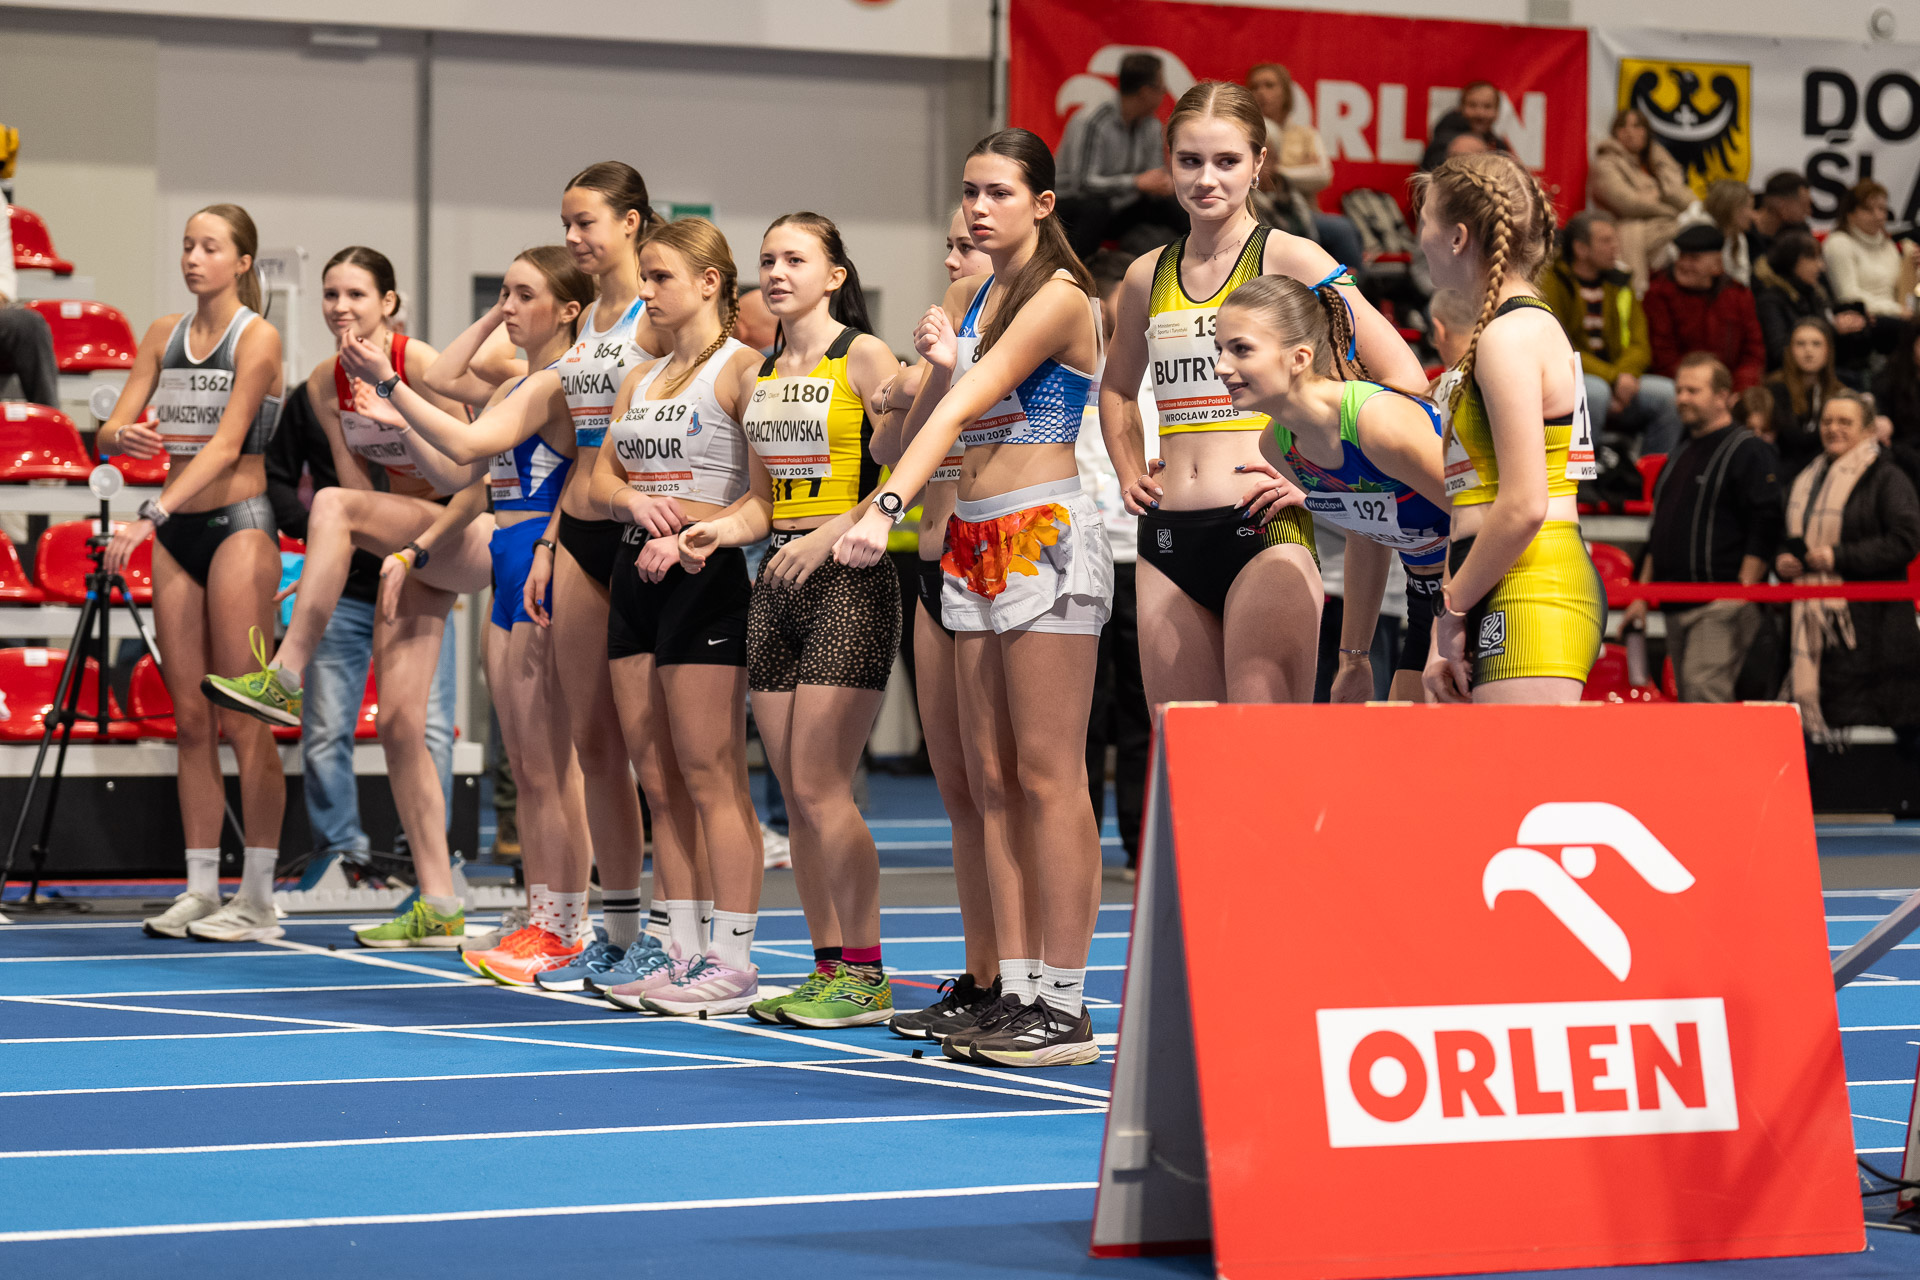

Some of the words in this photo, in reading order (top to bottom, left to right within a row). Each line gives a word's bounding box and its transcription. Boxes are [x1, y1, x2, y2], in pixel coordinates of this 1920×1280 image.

[593, 343, 623, 360] 864
[189, 374, 228, 392] 1362
[782, 383, 829, 404] 1180
[655, 404, 687, 421] 619
[1165, 410, 1209, 422] WROCŁAW
[1211, 408, 1240, 419] 2025
[745, 420, 824, 443] GRACZYKOWSKA
[987, 427, 1012, 440] 2025
[617, 438, 684, 460] CHODUR
[789, 467, 814, 476] 2025
[657, 483, 680, 492] 2025
[1353, 500, 1388, 522] 192
[1348, 1021, 1708, 1123] ORLEN
